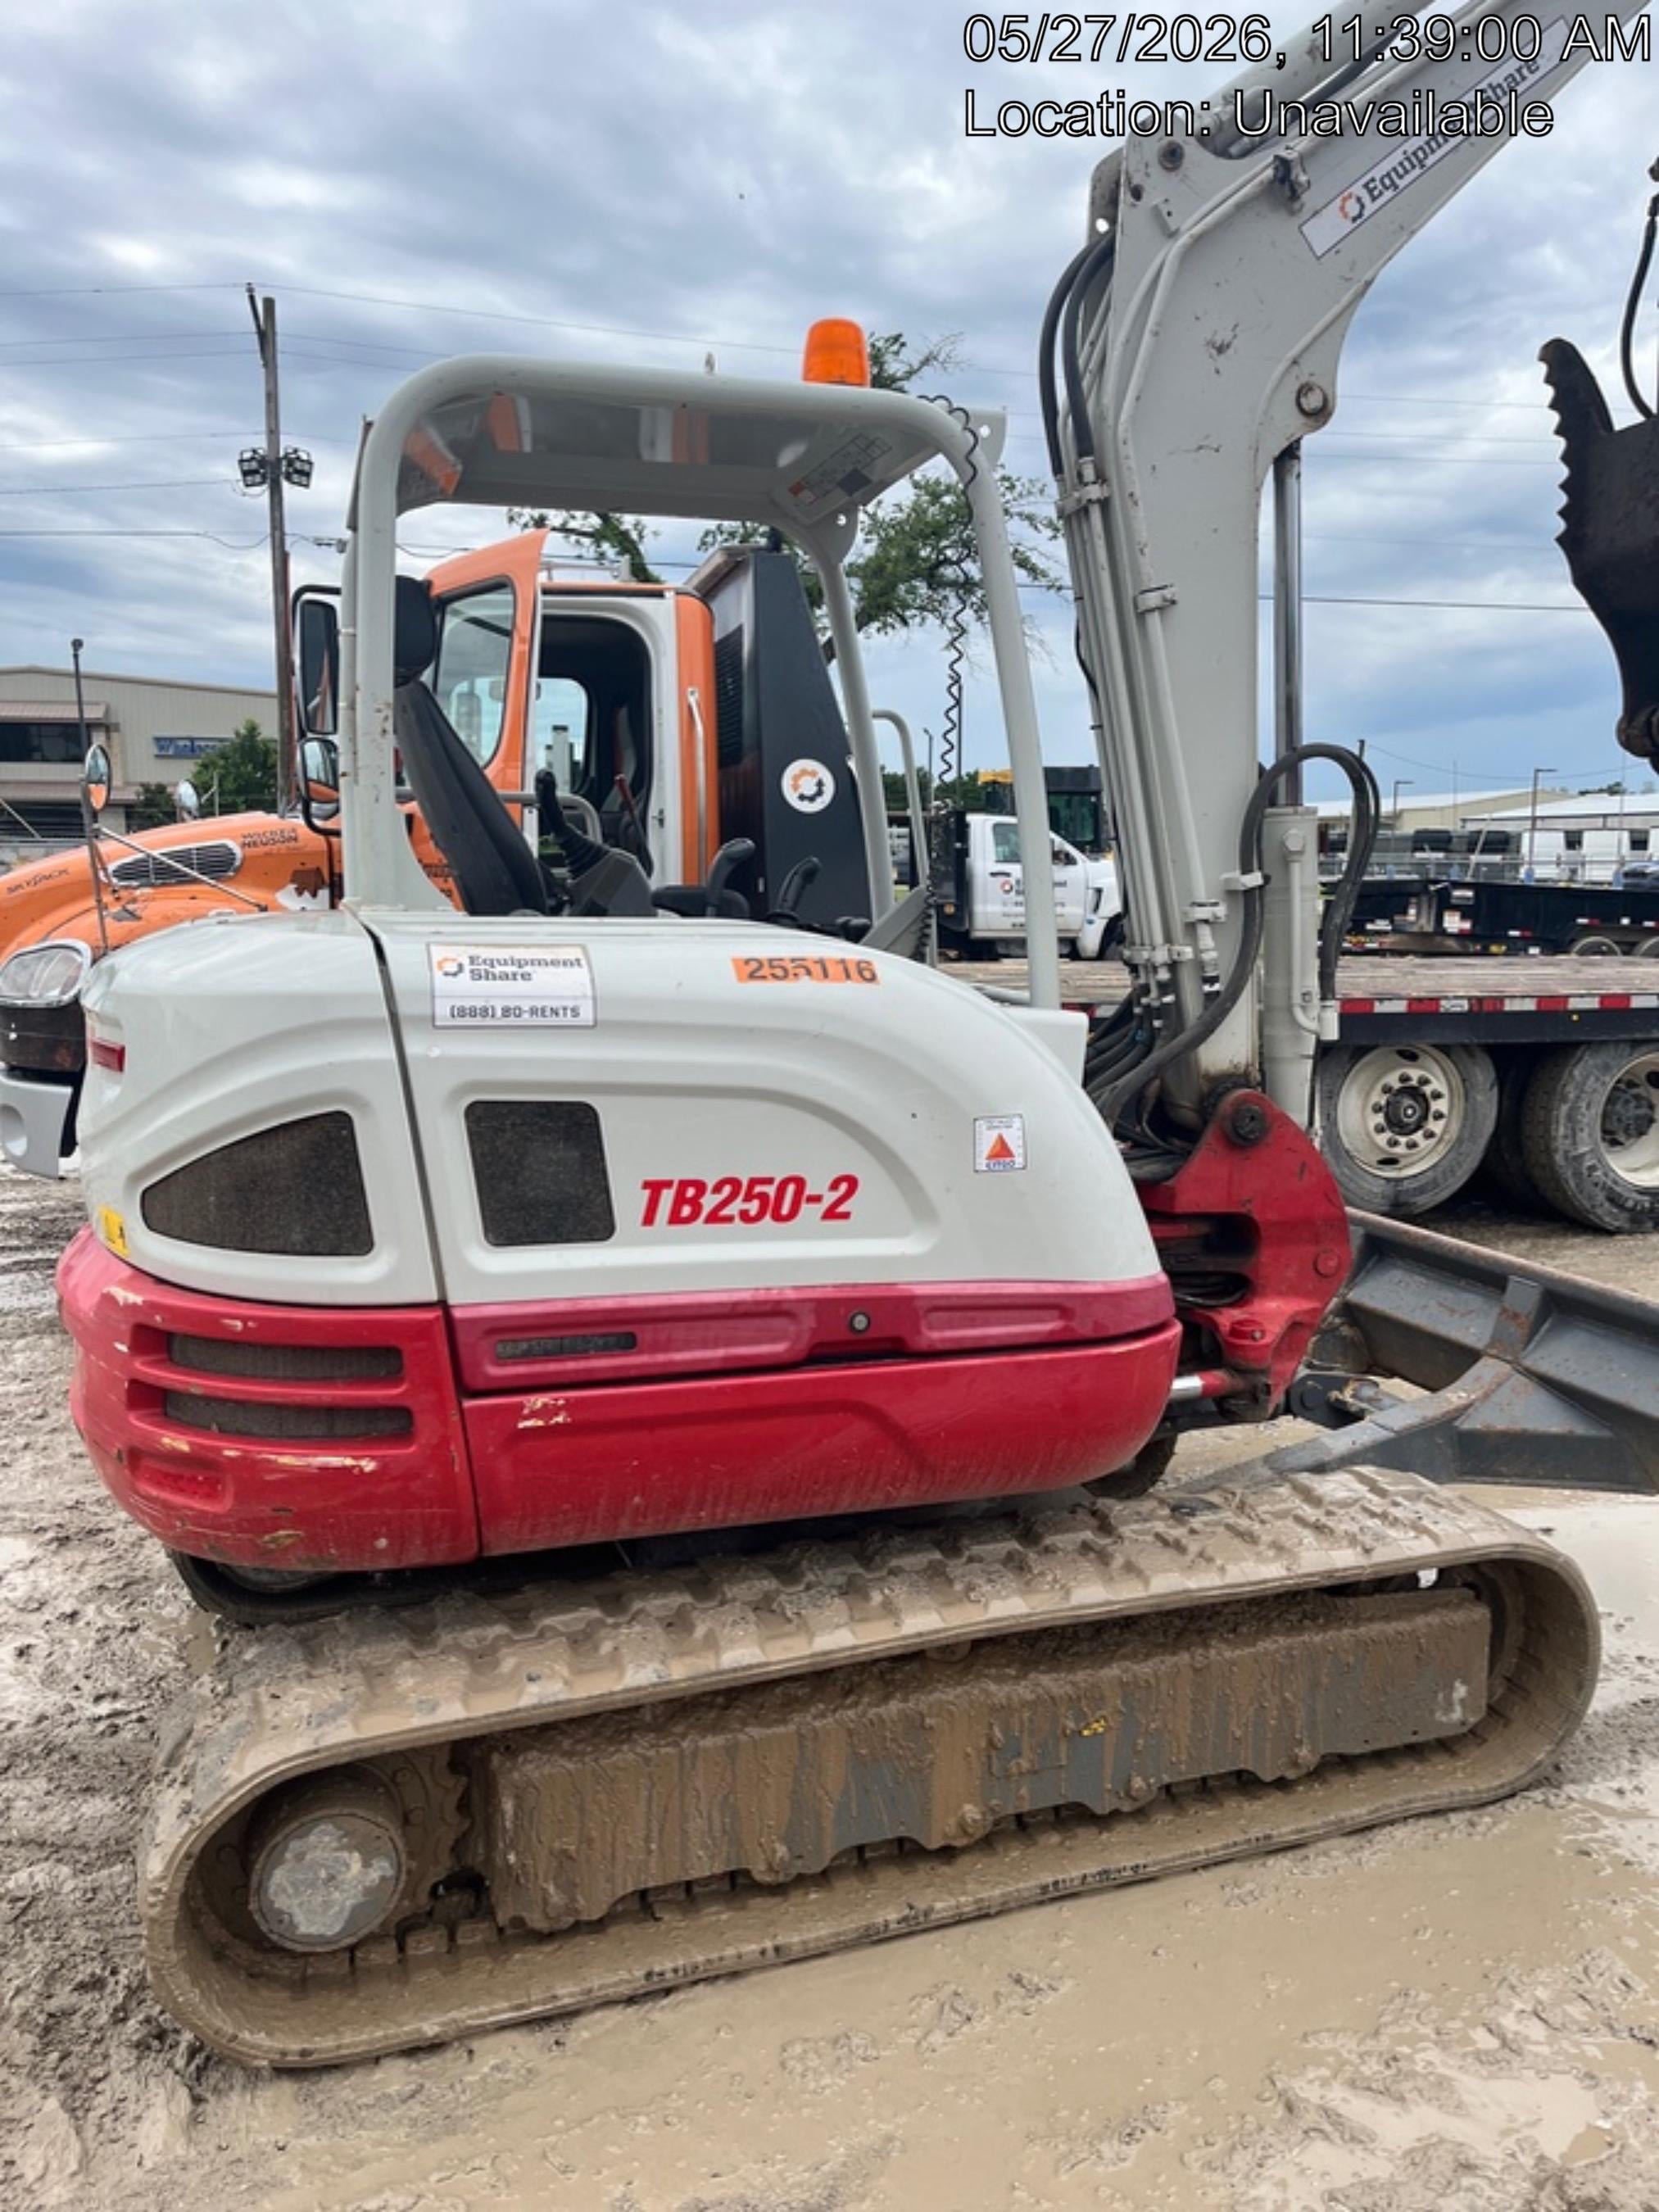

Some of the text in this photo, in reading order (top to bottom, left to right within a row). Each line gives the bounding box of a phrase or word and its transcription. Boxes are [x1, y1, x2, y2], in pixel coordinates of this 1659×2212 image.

[1362, 59, 1540, 203] EquipmShare
[469, 955, 582, 969] Equipment
[744, 958, 877, 983] 255116
[469, 968, 533, 981] Share
[451, 1004, 581, 1018] (888) 80-RENTS
[641, 1174, 859, 1226] TB250-2
